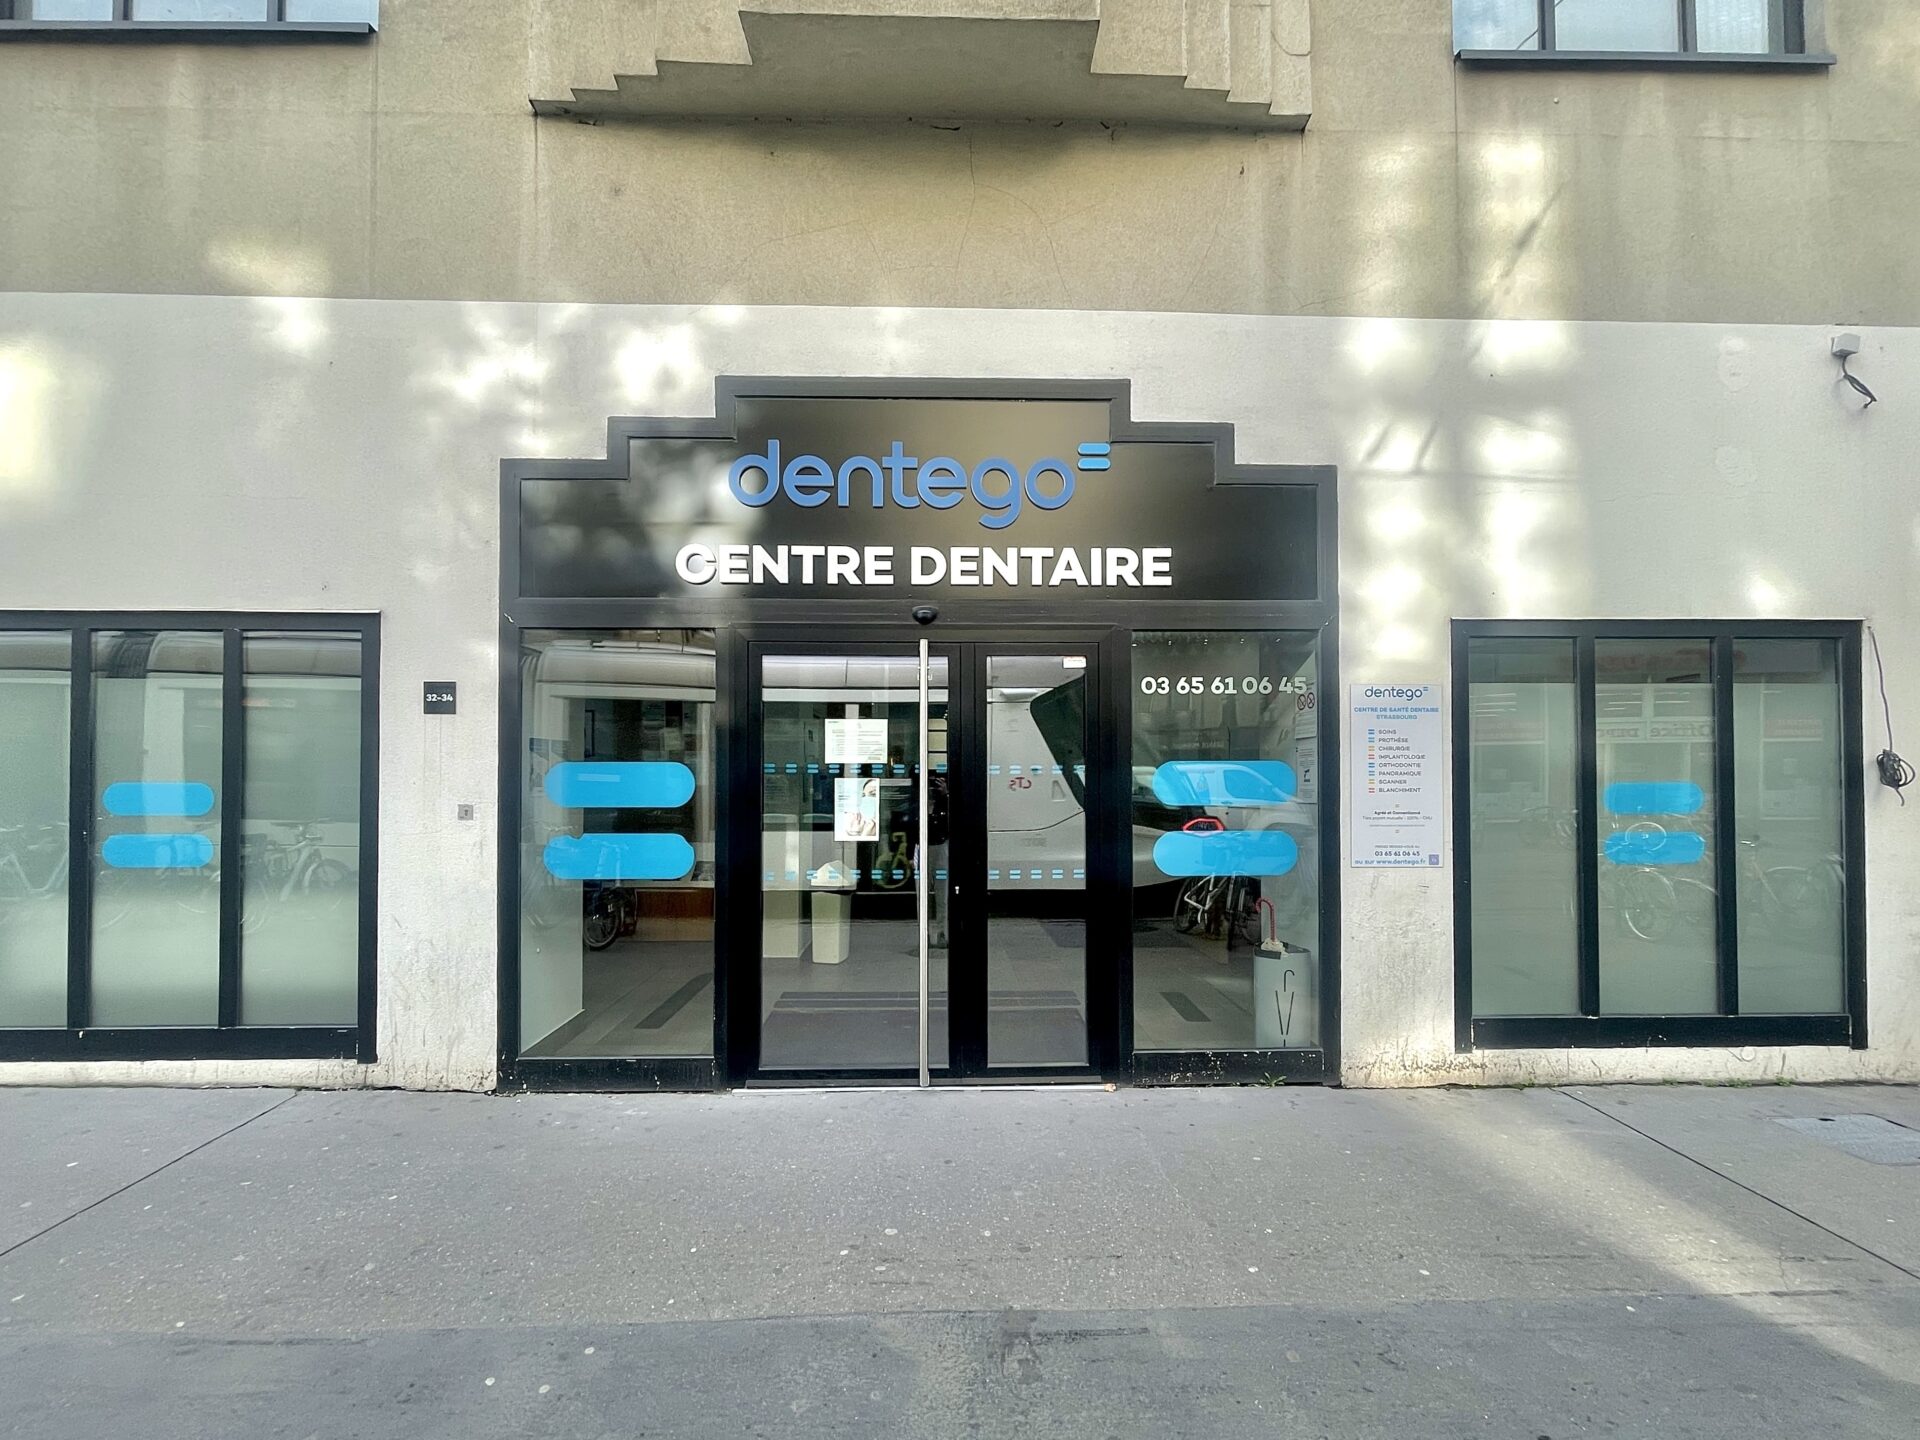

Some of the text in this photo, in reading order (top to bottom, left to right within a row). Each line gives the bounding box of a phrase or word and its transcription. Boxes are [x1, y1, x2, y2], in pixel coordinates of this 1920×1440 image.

[728, 439, 1075, 529] dentego
[675, 544, 1173, 587] CENTRE DENTAIRE
[1140, 676, 1308, 695] 03 65 61 06 45
[1364, 686, 1423, 701] dentego
[426, 693, 453, 702] 32-34
